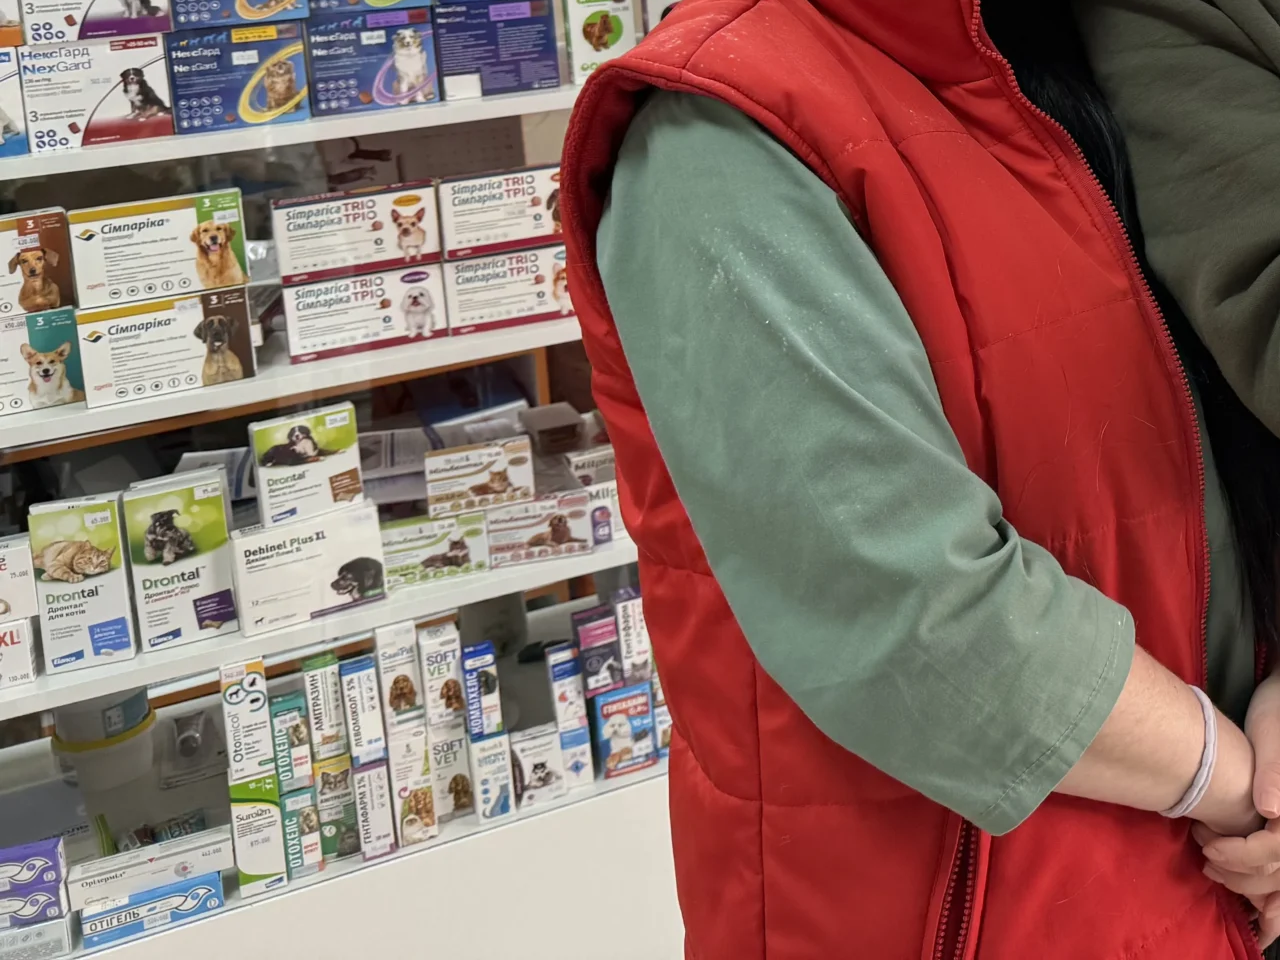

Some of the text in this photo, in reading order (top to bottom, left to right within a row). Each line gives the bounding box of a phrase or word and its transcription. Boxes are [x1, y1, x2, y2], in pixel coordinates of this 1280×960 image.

[25, 3, 35, 15] 3
[21, 47, 90, 62] НексГард
[23, 60, 92, 76] NexGard
[174, 60, 218, 74] NexGard
[30, 111, 39, 123] 3
[451, 174, 535, 196] Simparica TRIO
[452, 185, 536, 207] Сімпаріка ТРІО
[286, 198, 376, 220] Simparica TRIO
[101, 219, 166, 235] Сімпаріка
[286, 209, 377, 233] Сімпаріка ТРІО
[455, 252, 538, 275] Simparica TRIO
[455, 263, 539, 286] Сімпаріка ТРІО
[294, 275, 384, 301] Simparica TRIO
[295, 287, 385, 311] Сімпаріка ТРІО
[107, 317, 172, 336] Сімпаріка
[267, 471, 307, 488] Drontal
[244, 530, 327, 558] Dehinel Plus XL
[142, 567, 201, 590] Drontal
[45, 586, 99, 606] Drontal
[47, 603, 84, 616] Дронтал
[48, 608, 86, 622] для котів
[426, 648, 458, 667] SOFT
[427, 661, 452, 678] VET
[227, 712, 244, 763] Otomicol
[433, 738, 464, 756] SOFT
[434, 750, 459, 766] VET
[235, 807, 272, 823] Surolan
[81, 874, 123, 889] Орідерміл
[89, 909, 141, 933] ОТІГЕЛЬ
